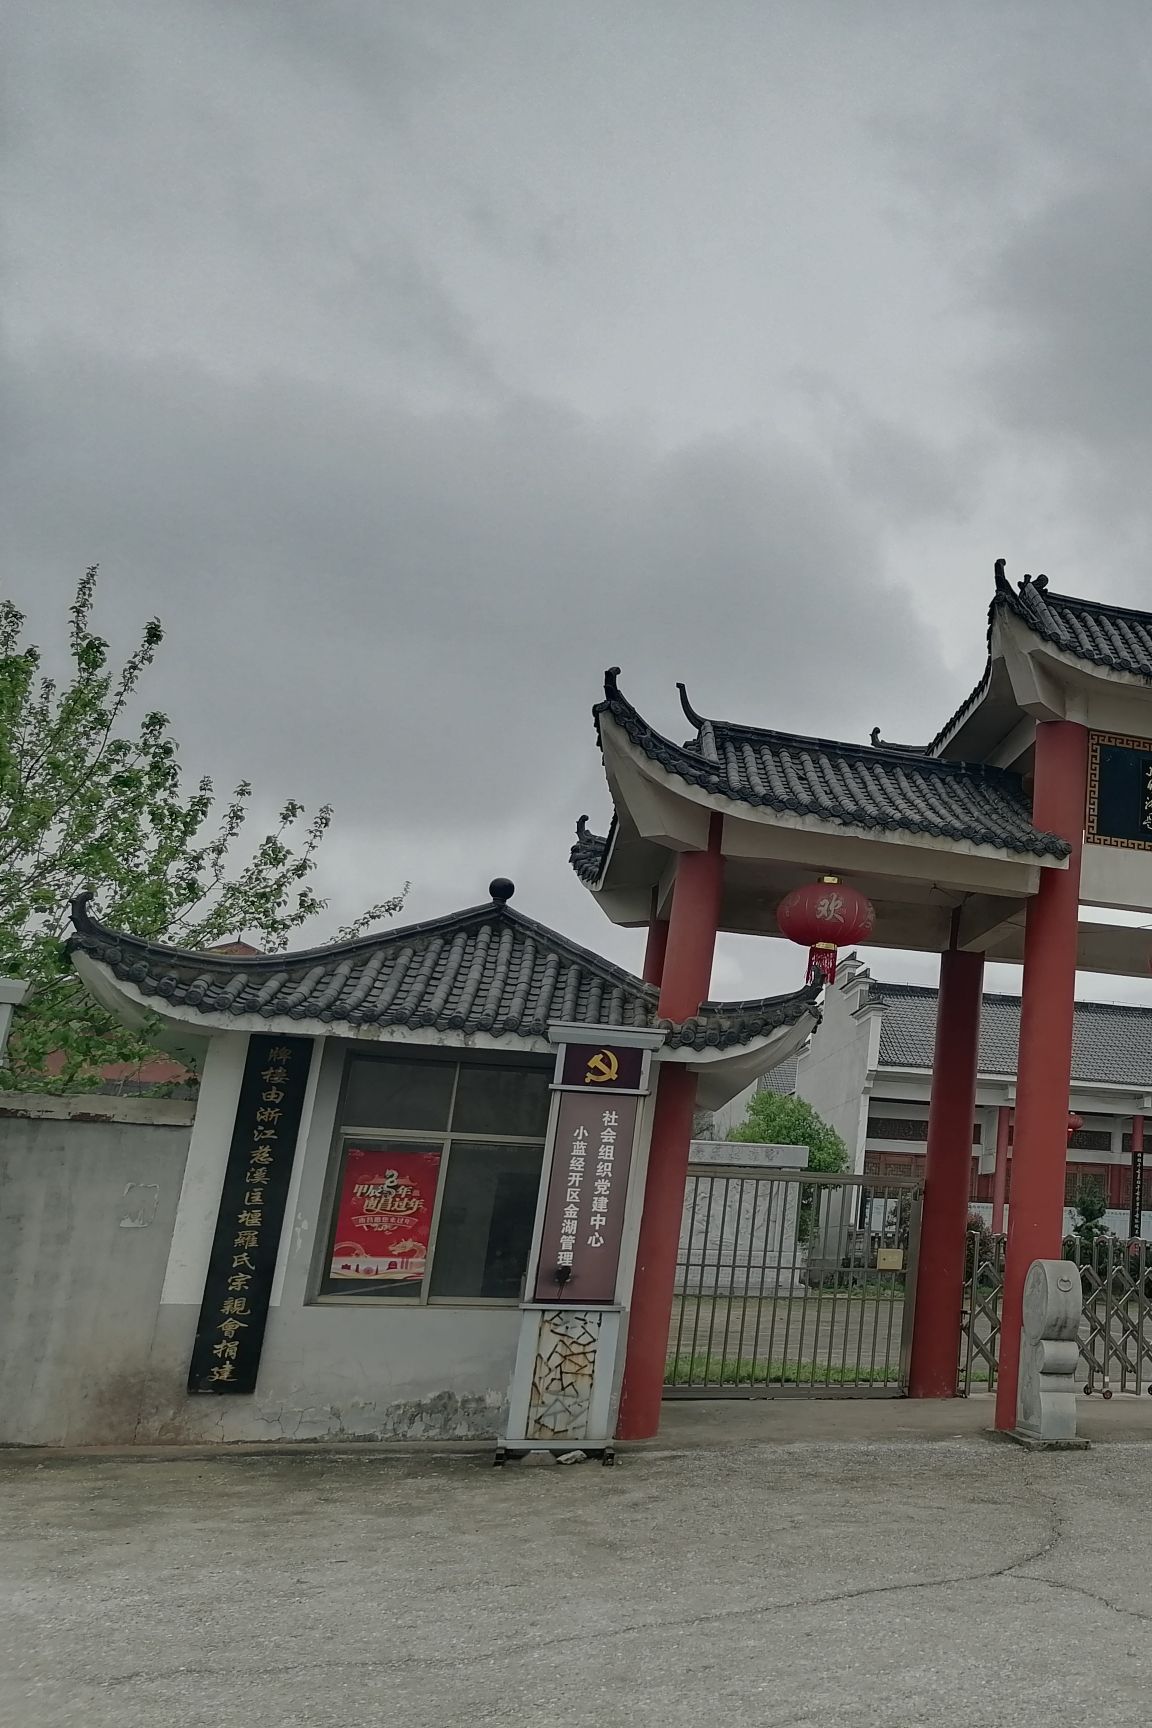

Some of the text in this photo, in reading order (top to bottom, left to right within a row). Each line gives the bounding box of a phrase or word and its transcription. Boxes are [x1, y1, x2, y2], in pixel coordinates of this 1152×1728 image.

[555, 1125, 589, 1282] 小蓝经开区金湖管理
[587, 1110, 619, 1248] 社会组织党建中心
